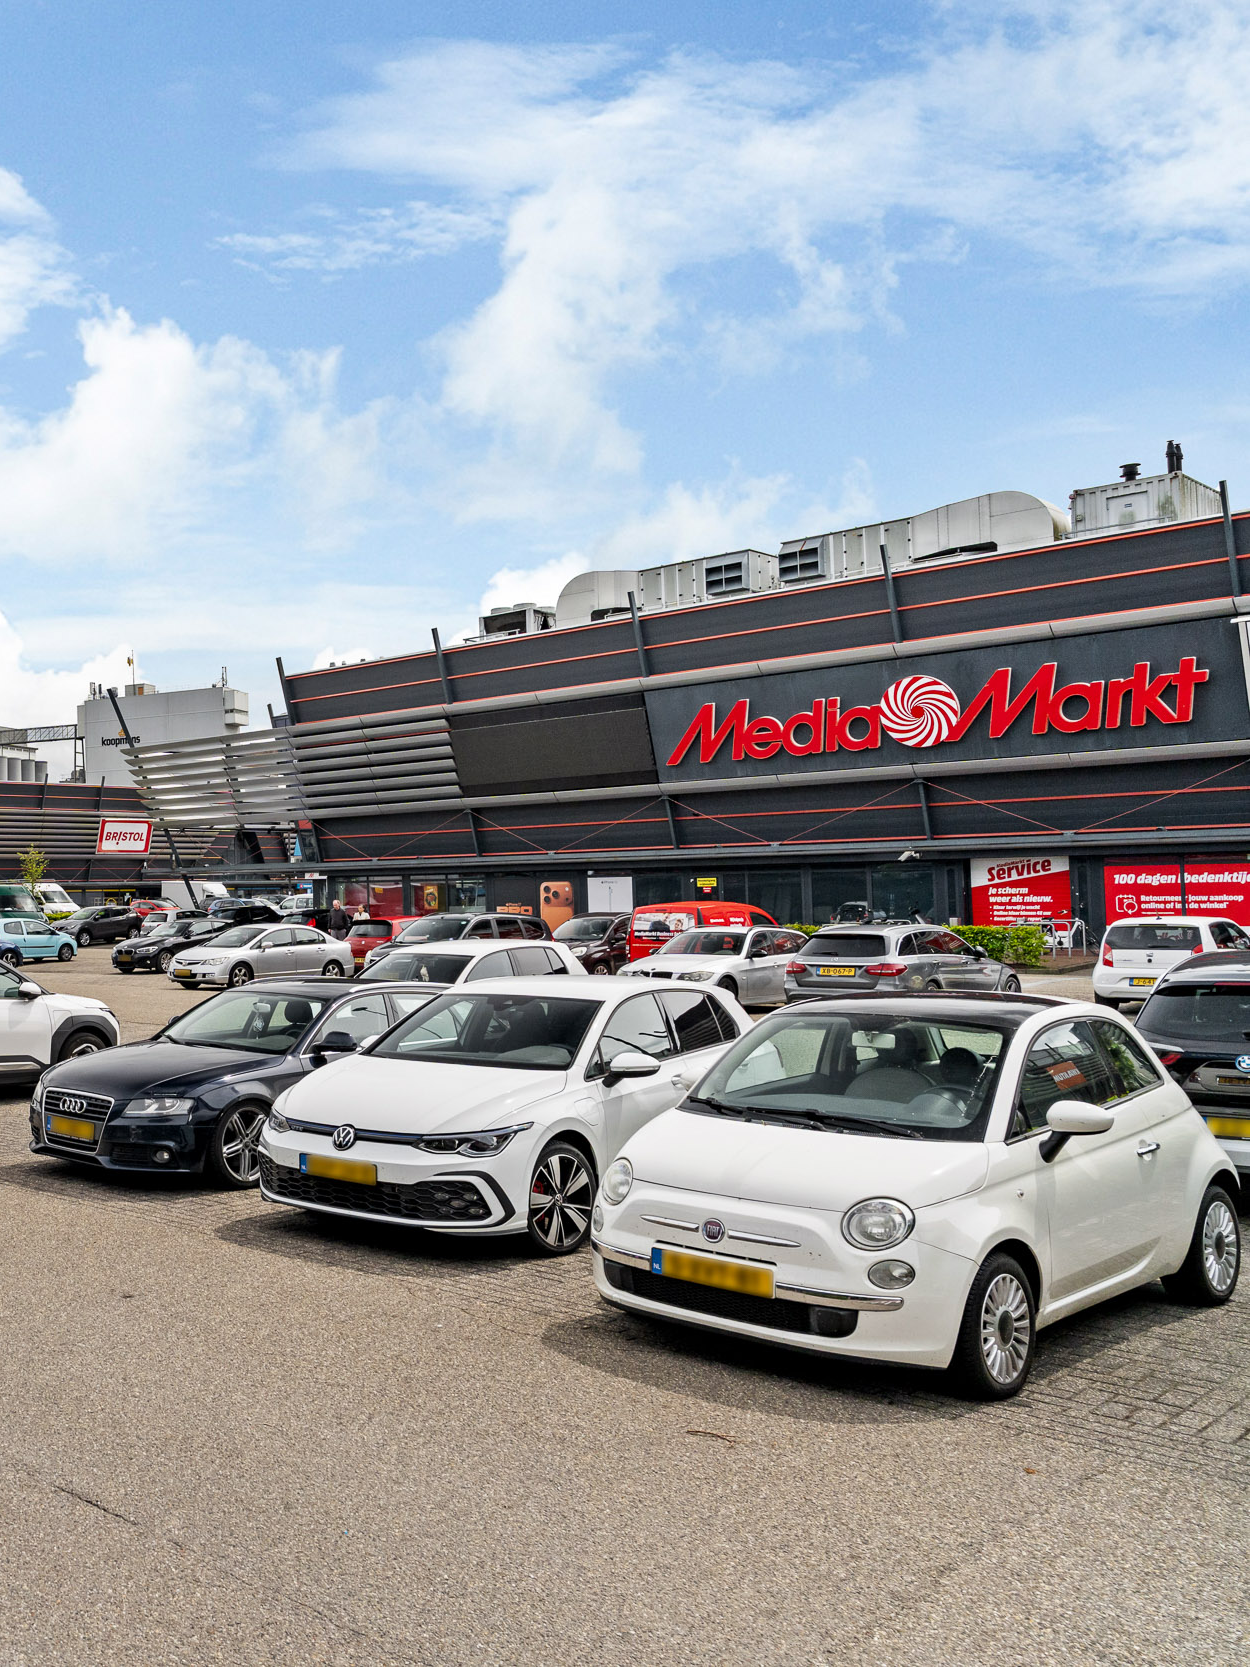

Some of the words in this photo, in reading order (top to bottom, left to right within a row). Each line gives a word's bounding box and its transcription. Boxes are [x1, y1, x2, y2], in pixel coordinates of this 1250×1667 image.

[666, 697, 882, 766] Media
[943, 657, 1209, 743] Markt
[101, 736, 140, 747] koopmns
[987, 859, 1052, 882] Service
[1114, 873, 1136, 884] 100
[1136, 873, 1176, 886] dagen
[997, 886, 1028, 894] scherm
[1011, 895, 1024, 903] als
[1023, 895, 1054, 903] nieuw.
[1188, 894, 1208, 903] jouw
[1209, 894, 1244, 903] aankoop
[821, 966, 853, 975] XB-067-P
[707, 1225, 720, 1237] FIAT
[653, 1262, 661, 1270] NL
